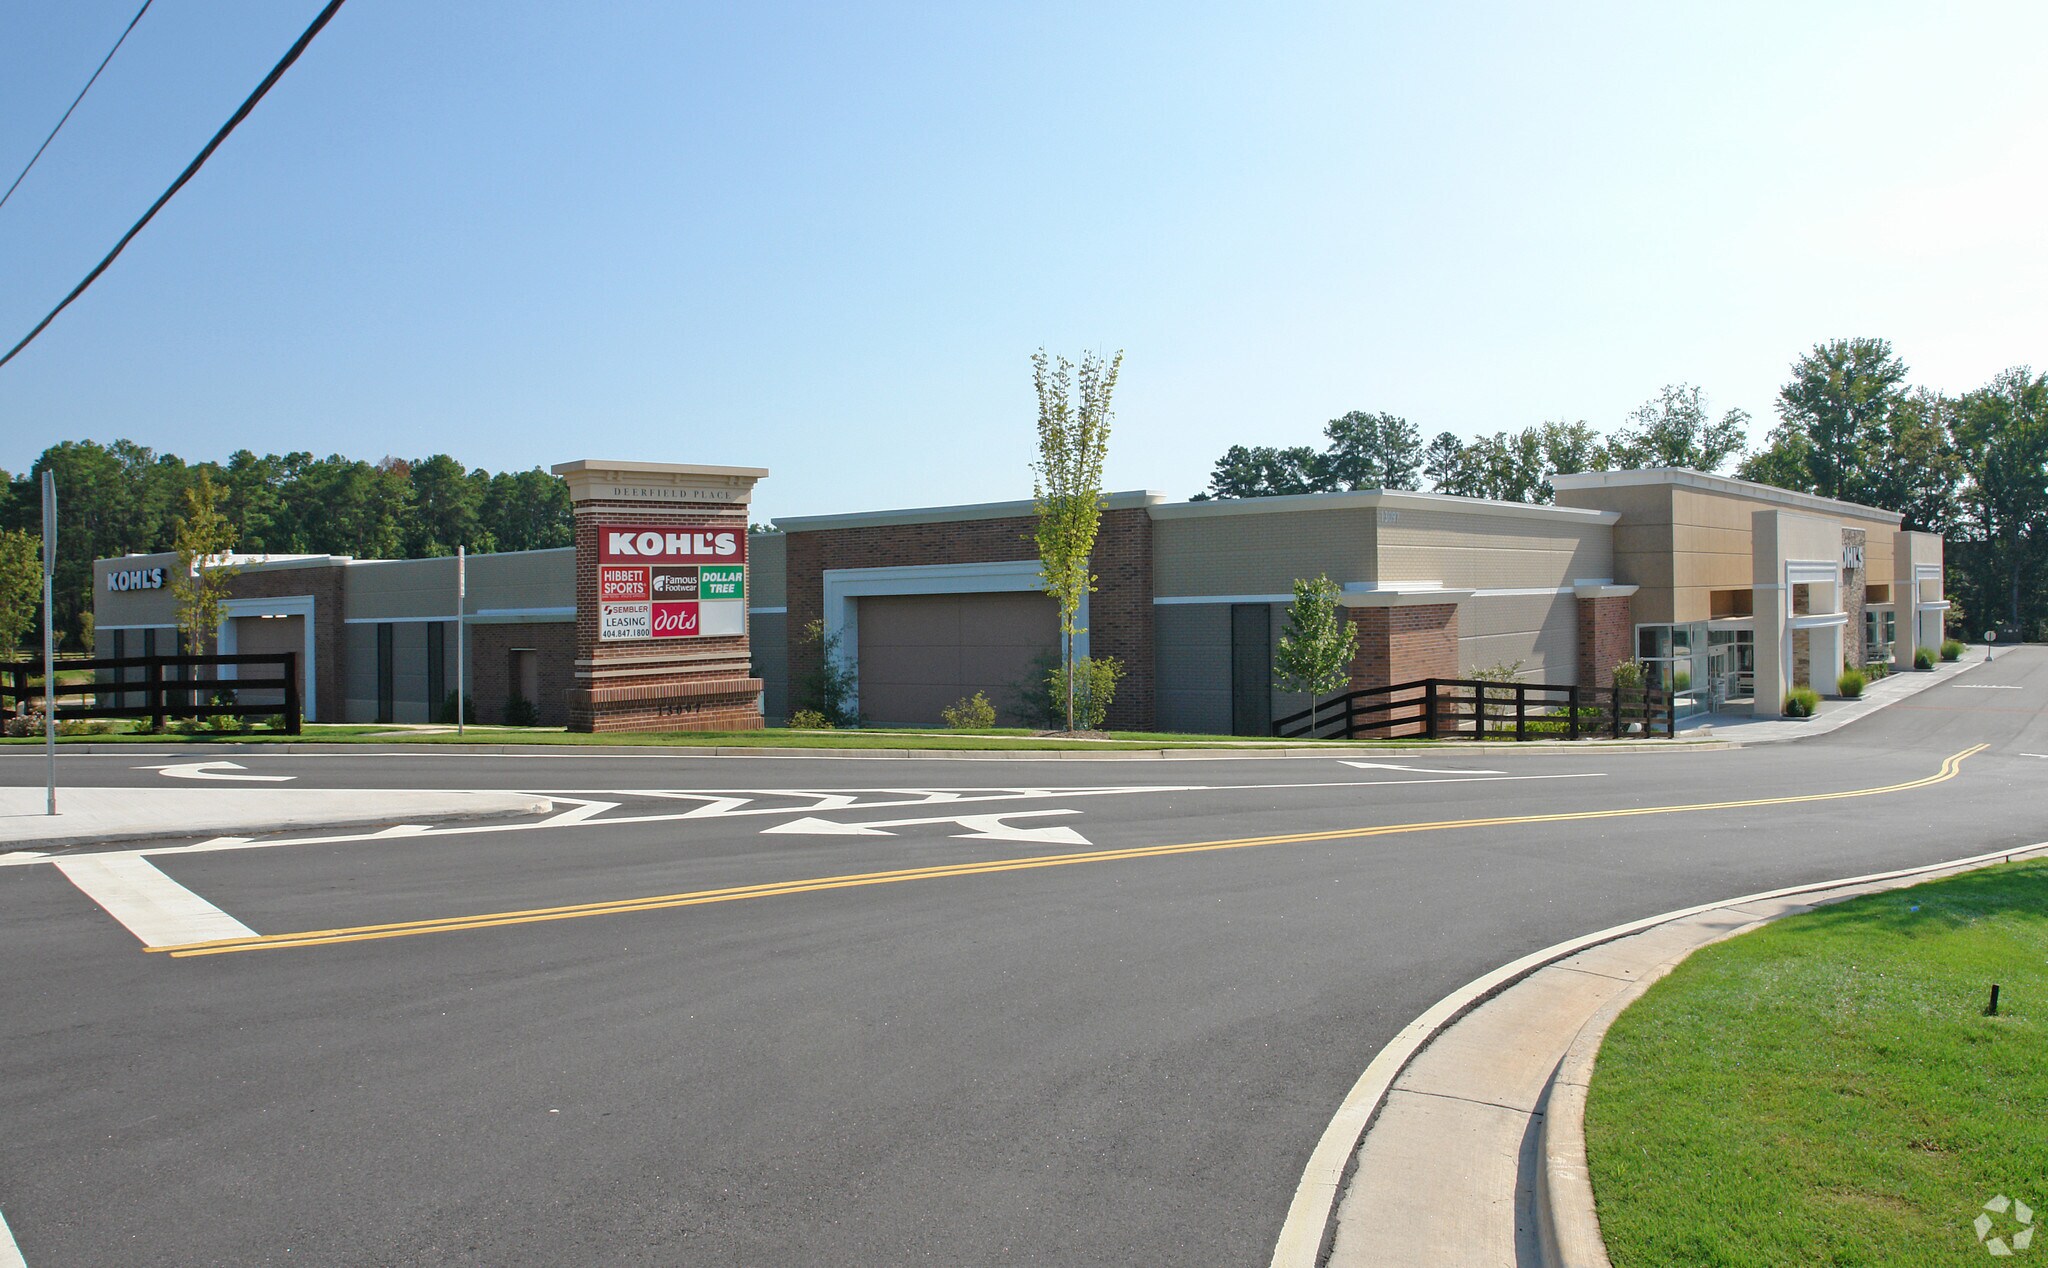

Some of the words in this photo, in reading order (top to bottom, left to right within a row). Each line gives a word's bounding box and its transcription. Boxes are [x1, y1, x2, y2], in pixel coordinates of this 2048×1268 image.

[613, 487, 687, 498] DEERFIELD
[694, 490, 732, 500] PLACE
[608, 531, 737, 556] KOHL'S
[1842, 546, 1863, 569] OHL'S
[107, 568, 162, 591] KOHL'S
[604, 570, 644, 582] HIBBETT
[665, 575, 697, 585] Famous
[702, 572, 743, 583] DOLLAR
[604, 582, 644, 594] SPORTS
[665, 584, 697, 592] Footwear
[709, 583, 735, 594] TREE
[612, 605, 649, 614] SEMBLER
[606, 617, 646, 627] LEASING
[654, 609, 697, 631] dots
[603, 628, 650, 638] 404.847.1800
